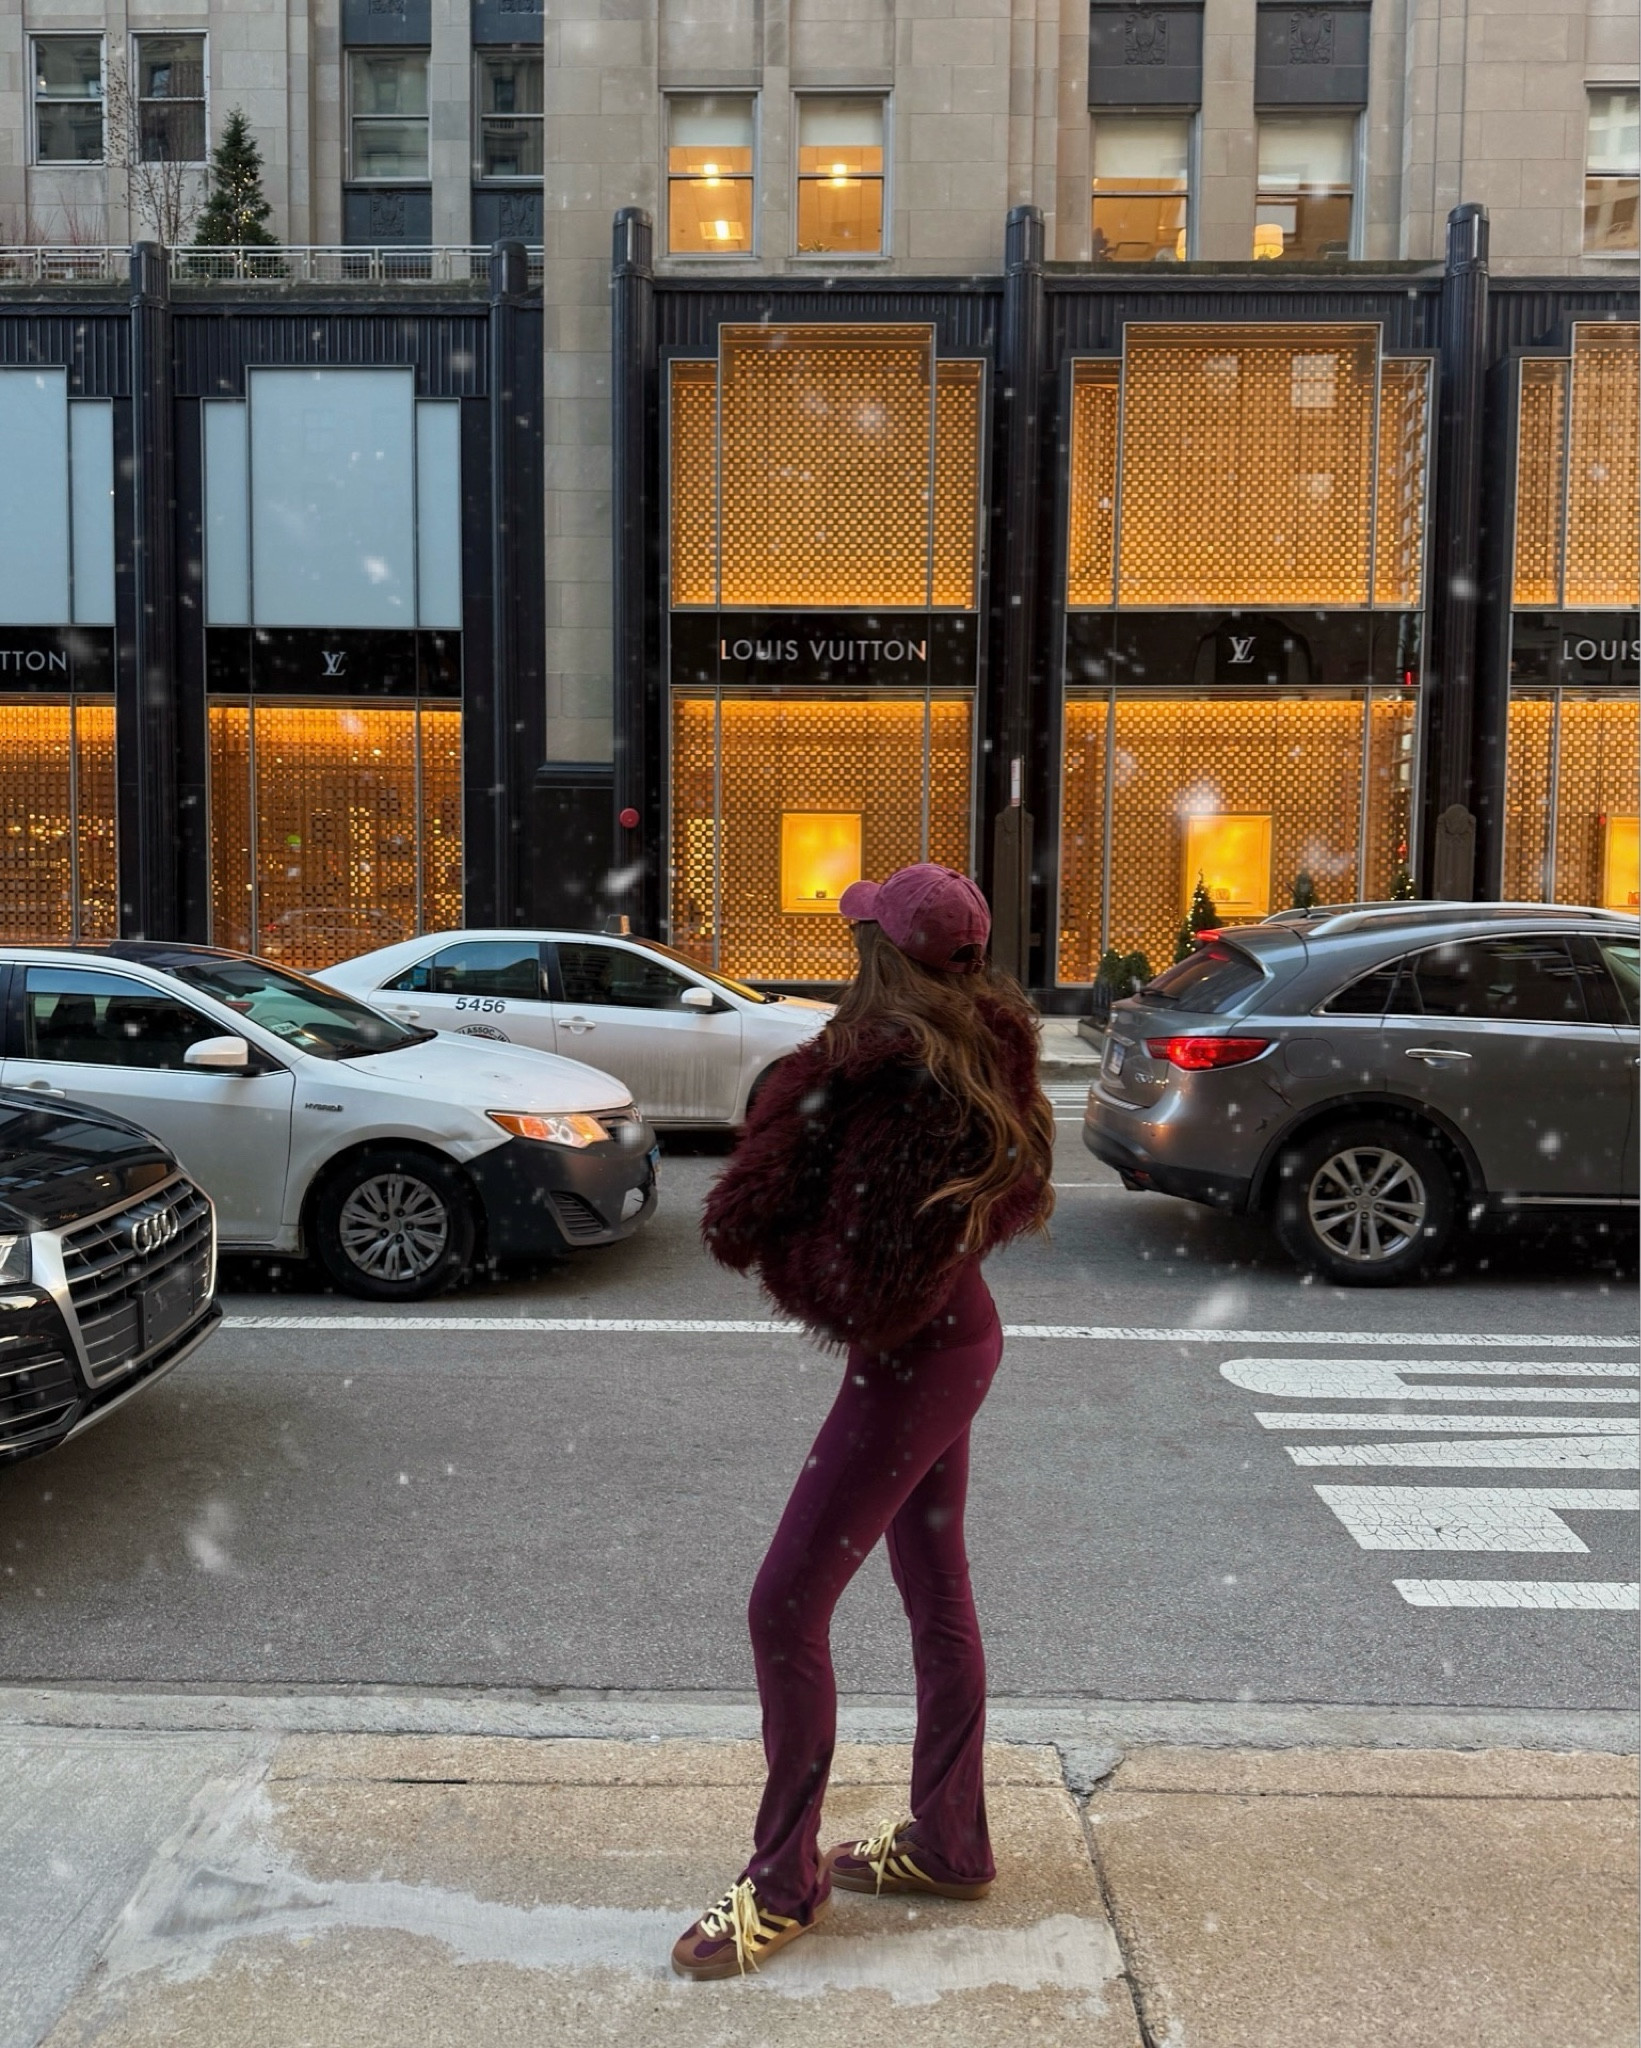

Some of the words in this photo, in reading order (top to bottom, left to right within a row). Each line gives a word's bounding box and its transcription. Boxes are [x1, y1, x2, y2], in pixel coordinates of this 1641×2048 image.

[721, 639, 799, 661] LOUIS
[809, 640, 927, 661] VUITTON
[1563, 640, 1641, 660] LOUIS
[0, 651, 67, 671] TTON
[455, 997, 506, 1014] 5456
